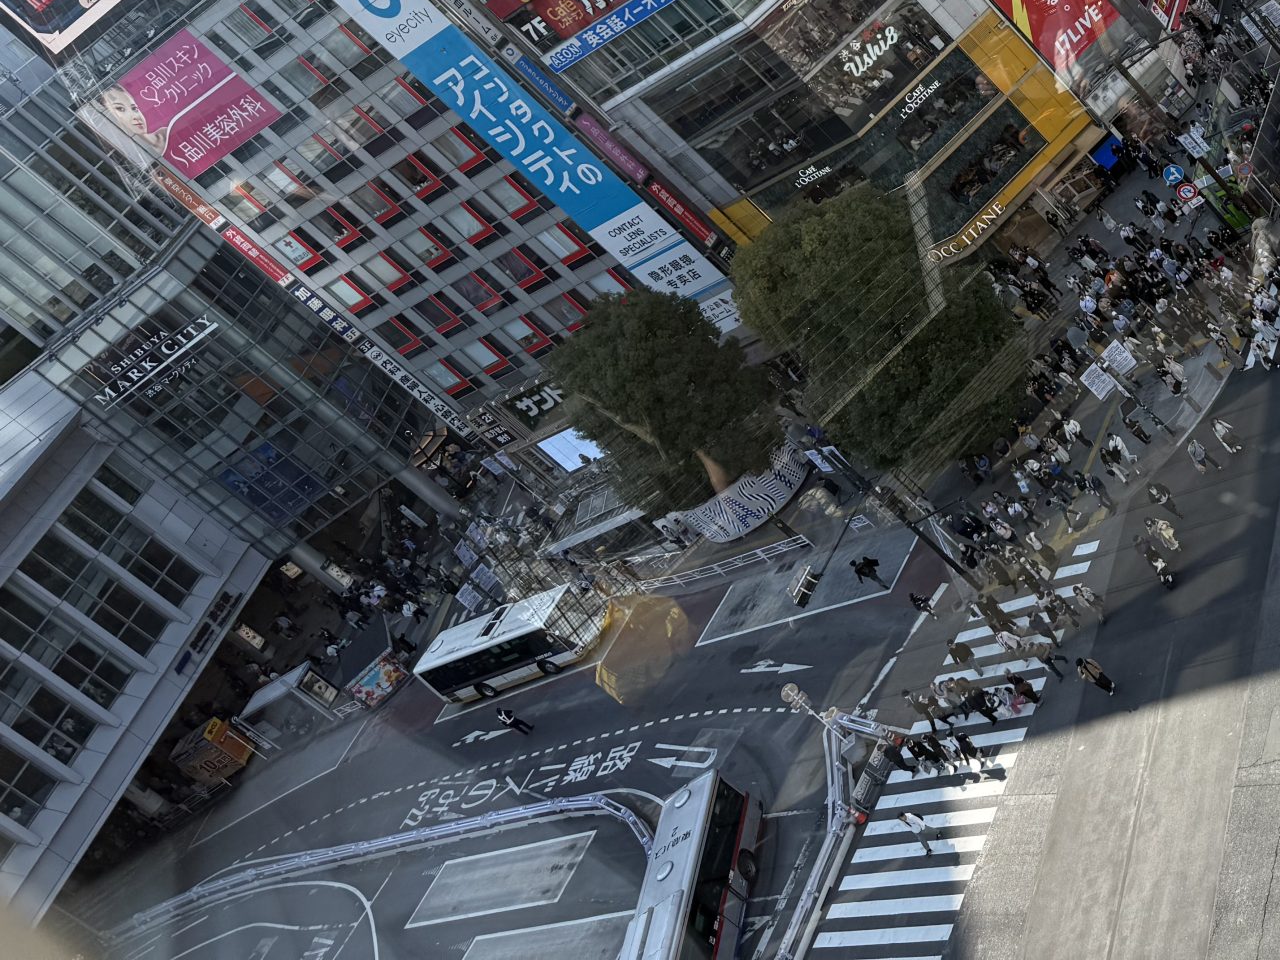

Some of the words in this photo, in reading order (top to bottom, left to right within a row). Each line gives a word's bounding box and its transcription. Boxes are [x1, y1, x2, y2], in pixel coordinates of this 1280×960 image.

[385, 6, 433, 44] eyecity
[520, 16, 549, 41] 7F
[1055, 4, 1103, 55] 17LIVE
[550, 43, 581, 67] AEON
[838, 39, 862, 62] 渋谷
[844, 25, 899, 78] Ushi8
[145, 44, 198, 89] 品川スキン
[167, 62, 212, 104] クリニック
[905, 83, 926, 103] CAFÉ
[900, 79, 941, 119] L'OCCITANE
[179, 93, 267, 163] 品川美容外科
[432, 68, 581, 195] アイシティ
[459, 54, 603, 185] コンタクトの
[794, 165, 833, 188] L'OCCITANE
[798, 164, 818, 177] CAFÉ
[650, 183, 685, 215] 外貨両替
[608, 215, 644, 238] CONTACT
[623, 227, 645, 243] LENS
[225, 229, 260, 258] 外貨両替
[619, 228, 668, 258] SPECIALISTS
[647, 253, 696, 283] 隐形眼镜
[666, 267, 702, 290] 专卖店
[295, 286, 348, 331] 加藤眼科
[345, 329, 358, 342] 5F
[94, 356, 159, 406] MARK
[160, 313, 213, 355] CITY
[110, 330, 170, 375] SHIBUYA
[359, 341, 374, 354] 3F
[380, 359, 401, 377] 内科
[161, 357, 198, 385] マークシティ
[481, 413, 494, 424] 2F
